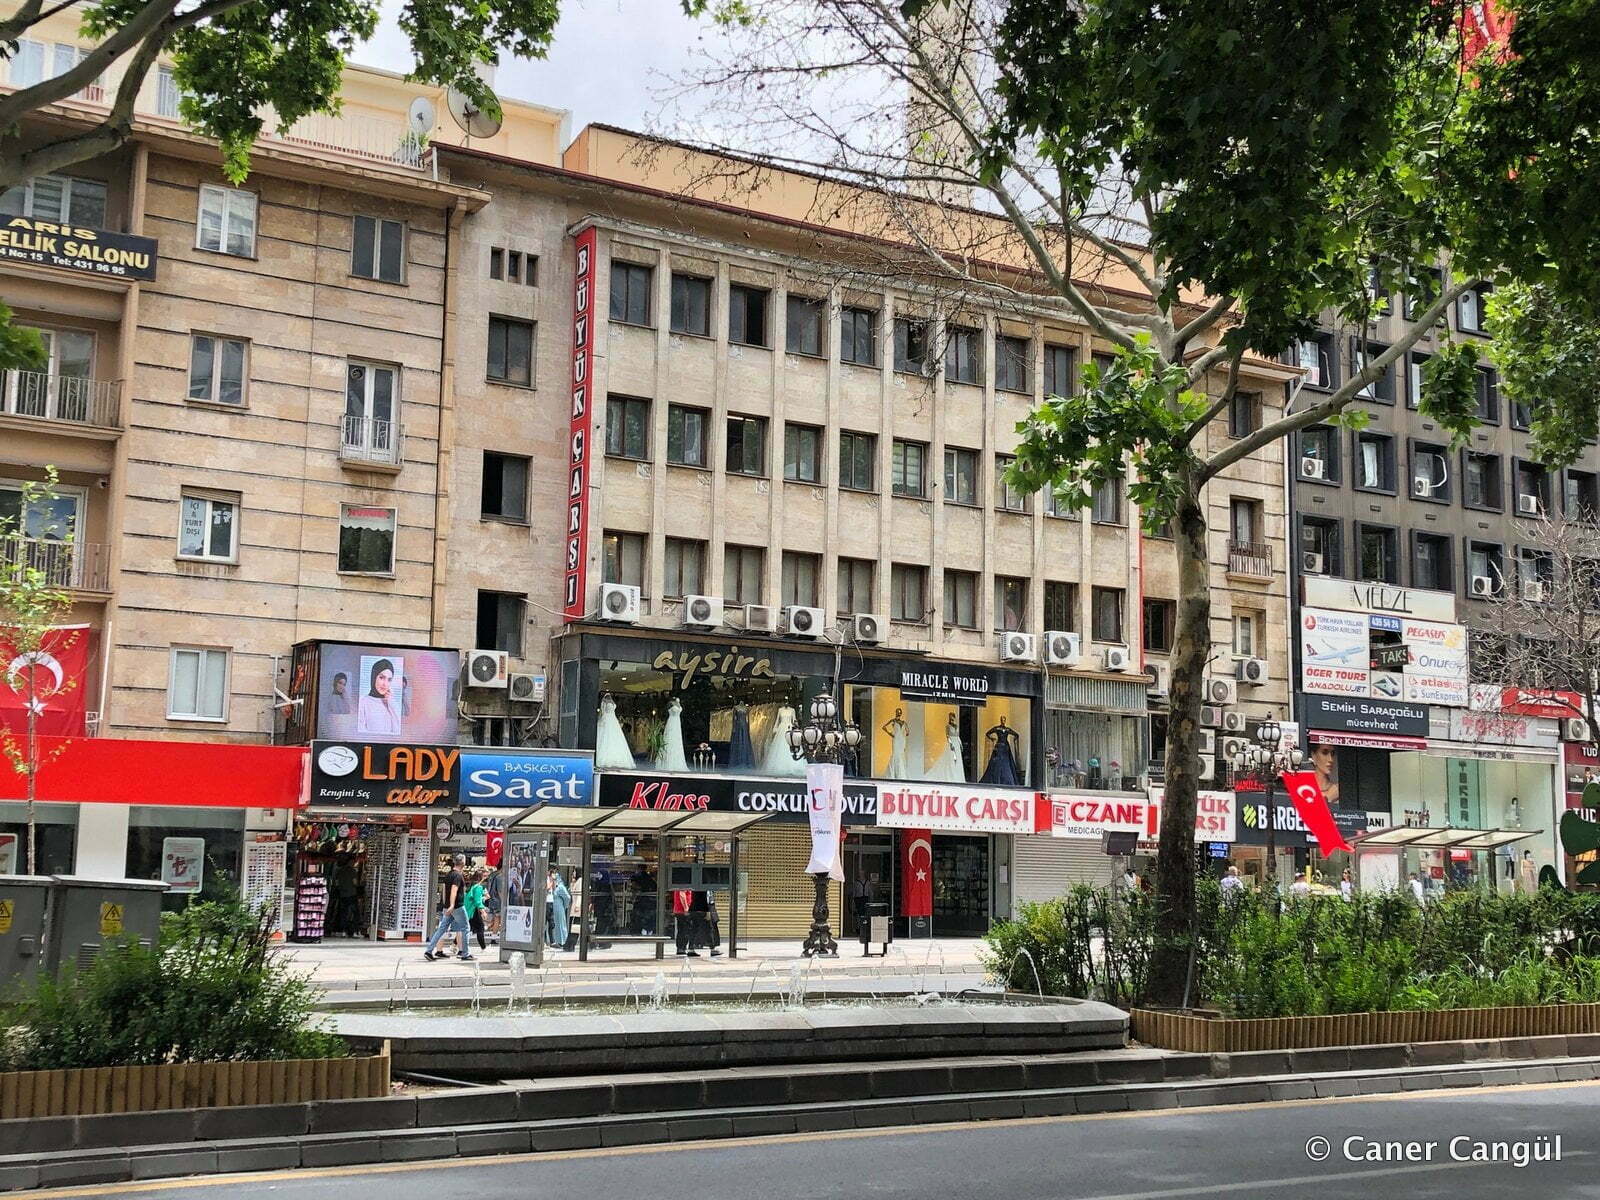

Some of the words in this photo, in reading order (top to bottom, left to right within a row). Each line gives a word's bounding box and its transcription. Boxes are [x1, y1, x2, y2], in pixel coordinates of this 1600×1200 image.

[8, 218, 97, 240] ARİS
[9, 249, 27, 259] No:
[30, 252, 43, 262] 15
[52, 256, 71, 267] Tel:
[73, 260, 93, 270] 431
[63, 241, 149, 269] SALONU
[573, 249, 588, 416] BÜYÜK
[185, 519, 203, 527] YURT
[568, 430, 583, 603] ÇARŞI
[1407, 627, 1447, 639] PEGASUS
[654, 646, 774, 690] aysira
[1336, 671, 1367, 681] TOURS
[901, 672, 949, 690] MIRACLE
[953, 676, 988, 692] WORLD
[1321, 701, 1356, 713] SEMİH
[1360, 705, 1424, 719] SARAÇOĞLU
[1346, 718, 1399, 730] mücevherat
[363, 746, 461, 781] LADY
[320, 788, 355, 800] Rengini
[357, 789, 371, 800] Seç
[386, 784, 443, 805] color
[468, 769, 585, 800] Saat
[882, 788, 959, 818] BÜYÜK
[965, 796, 1029, 825] ÇARŞI
